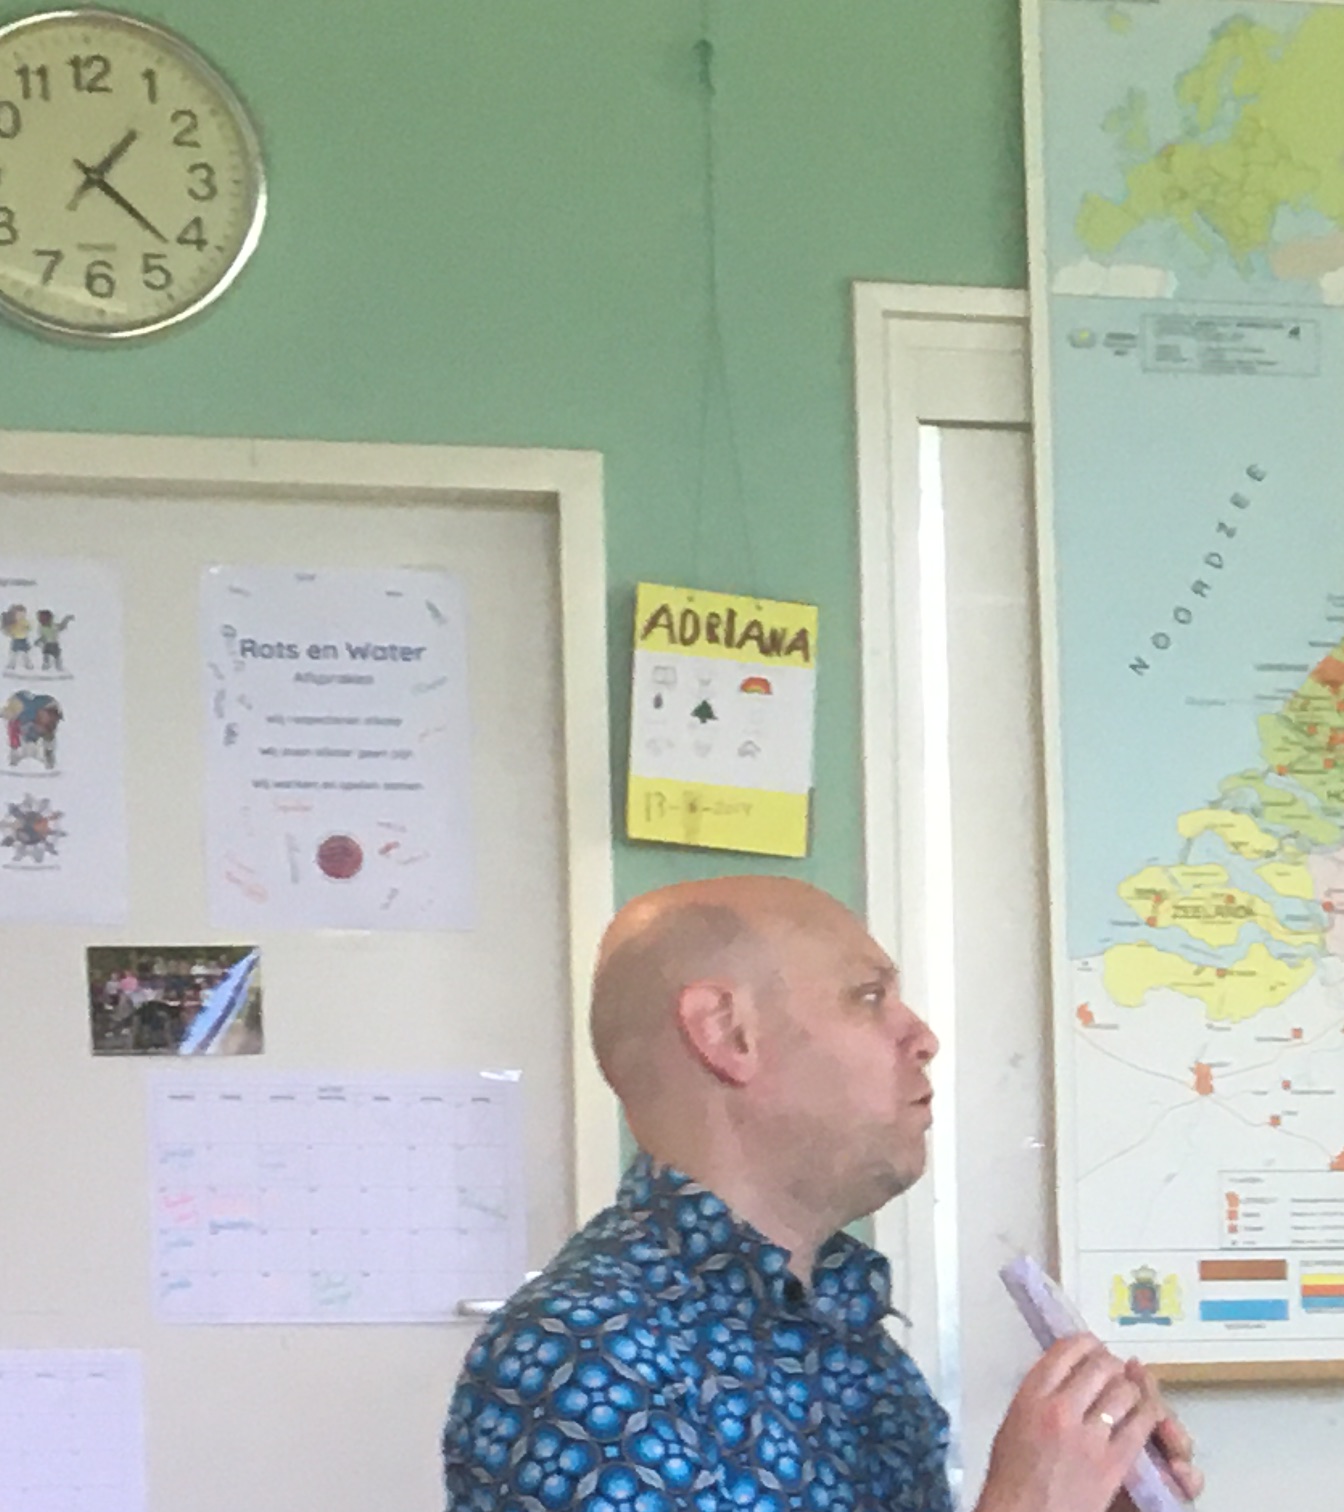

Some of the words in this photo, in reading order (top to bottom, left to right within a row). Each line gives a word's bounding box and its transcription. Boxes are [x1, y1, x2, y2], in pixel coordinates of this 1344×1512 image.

[15, 63, 50, 101] 11
[67, 54, 113, 93] 12
[141, 68, 158, 105] 1
[0, 100, 22, 139] 0
[170, 109, 201, 149] 2
[187, 162, 218, 202] 3
[176, 216, 208, 251] 4
[33, 249, 64, 286] 7
[85, 260, 116, 299] 6
[142, 253, 173, 291] 5
[1128, 463, 1268, 676] NOORDZEE
[239, 638, 299, 660] Rots
[307, 643, 338, 661] en
[346, 642, 427, 662] Water
[640, 603, 811, 662] ADRIANA
